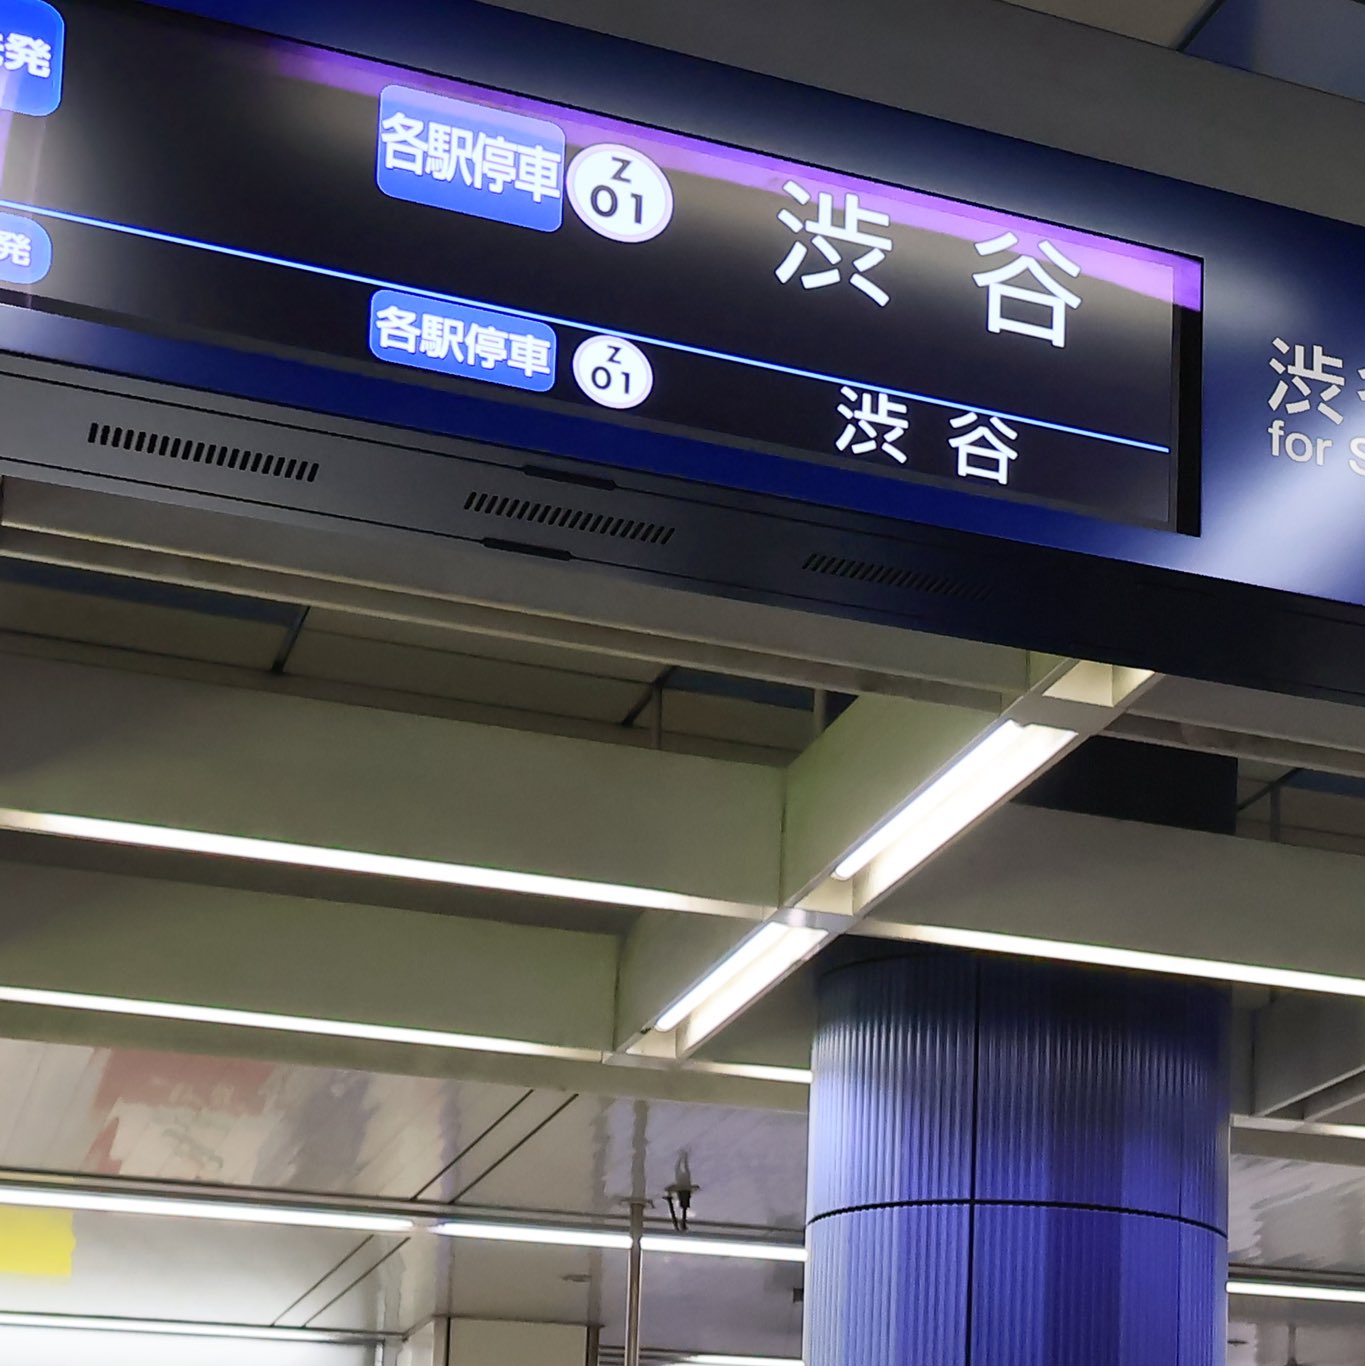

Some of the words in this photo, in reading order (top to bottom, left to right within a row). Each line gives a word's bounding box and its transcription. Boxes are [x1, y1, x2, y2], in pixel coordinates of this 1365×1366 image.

[0, 32, 52, 79] 発
[381, 111, 561, 203] 各駅停車
[611, 156, 632, 183] Z
[590, 185, 643, 225] 01
[775, 179, 1082, 350] 渋谷
[376, 305, 551, 377] 各駅停車
[607, 345, 622, 364] Z
[590, 366, 631, 395] 01
[834, 385, 1020, 487] 渋谷
[1268, 420, 1335, 468] for
